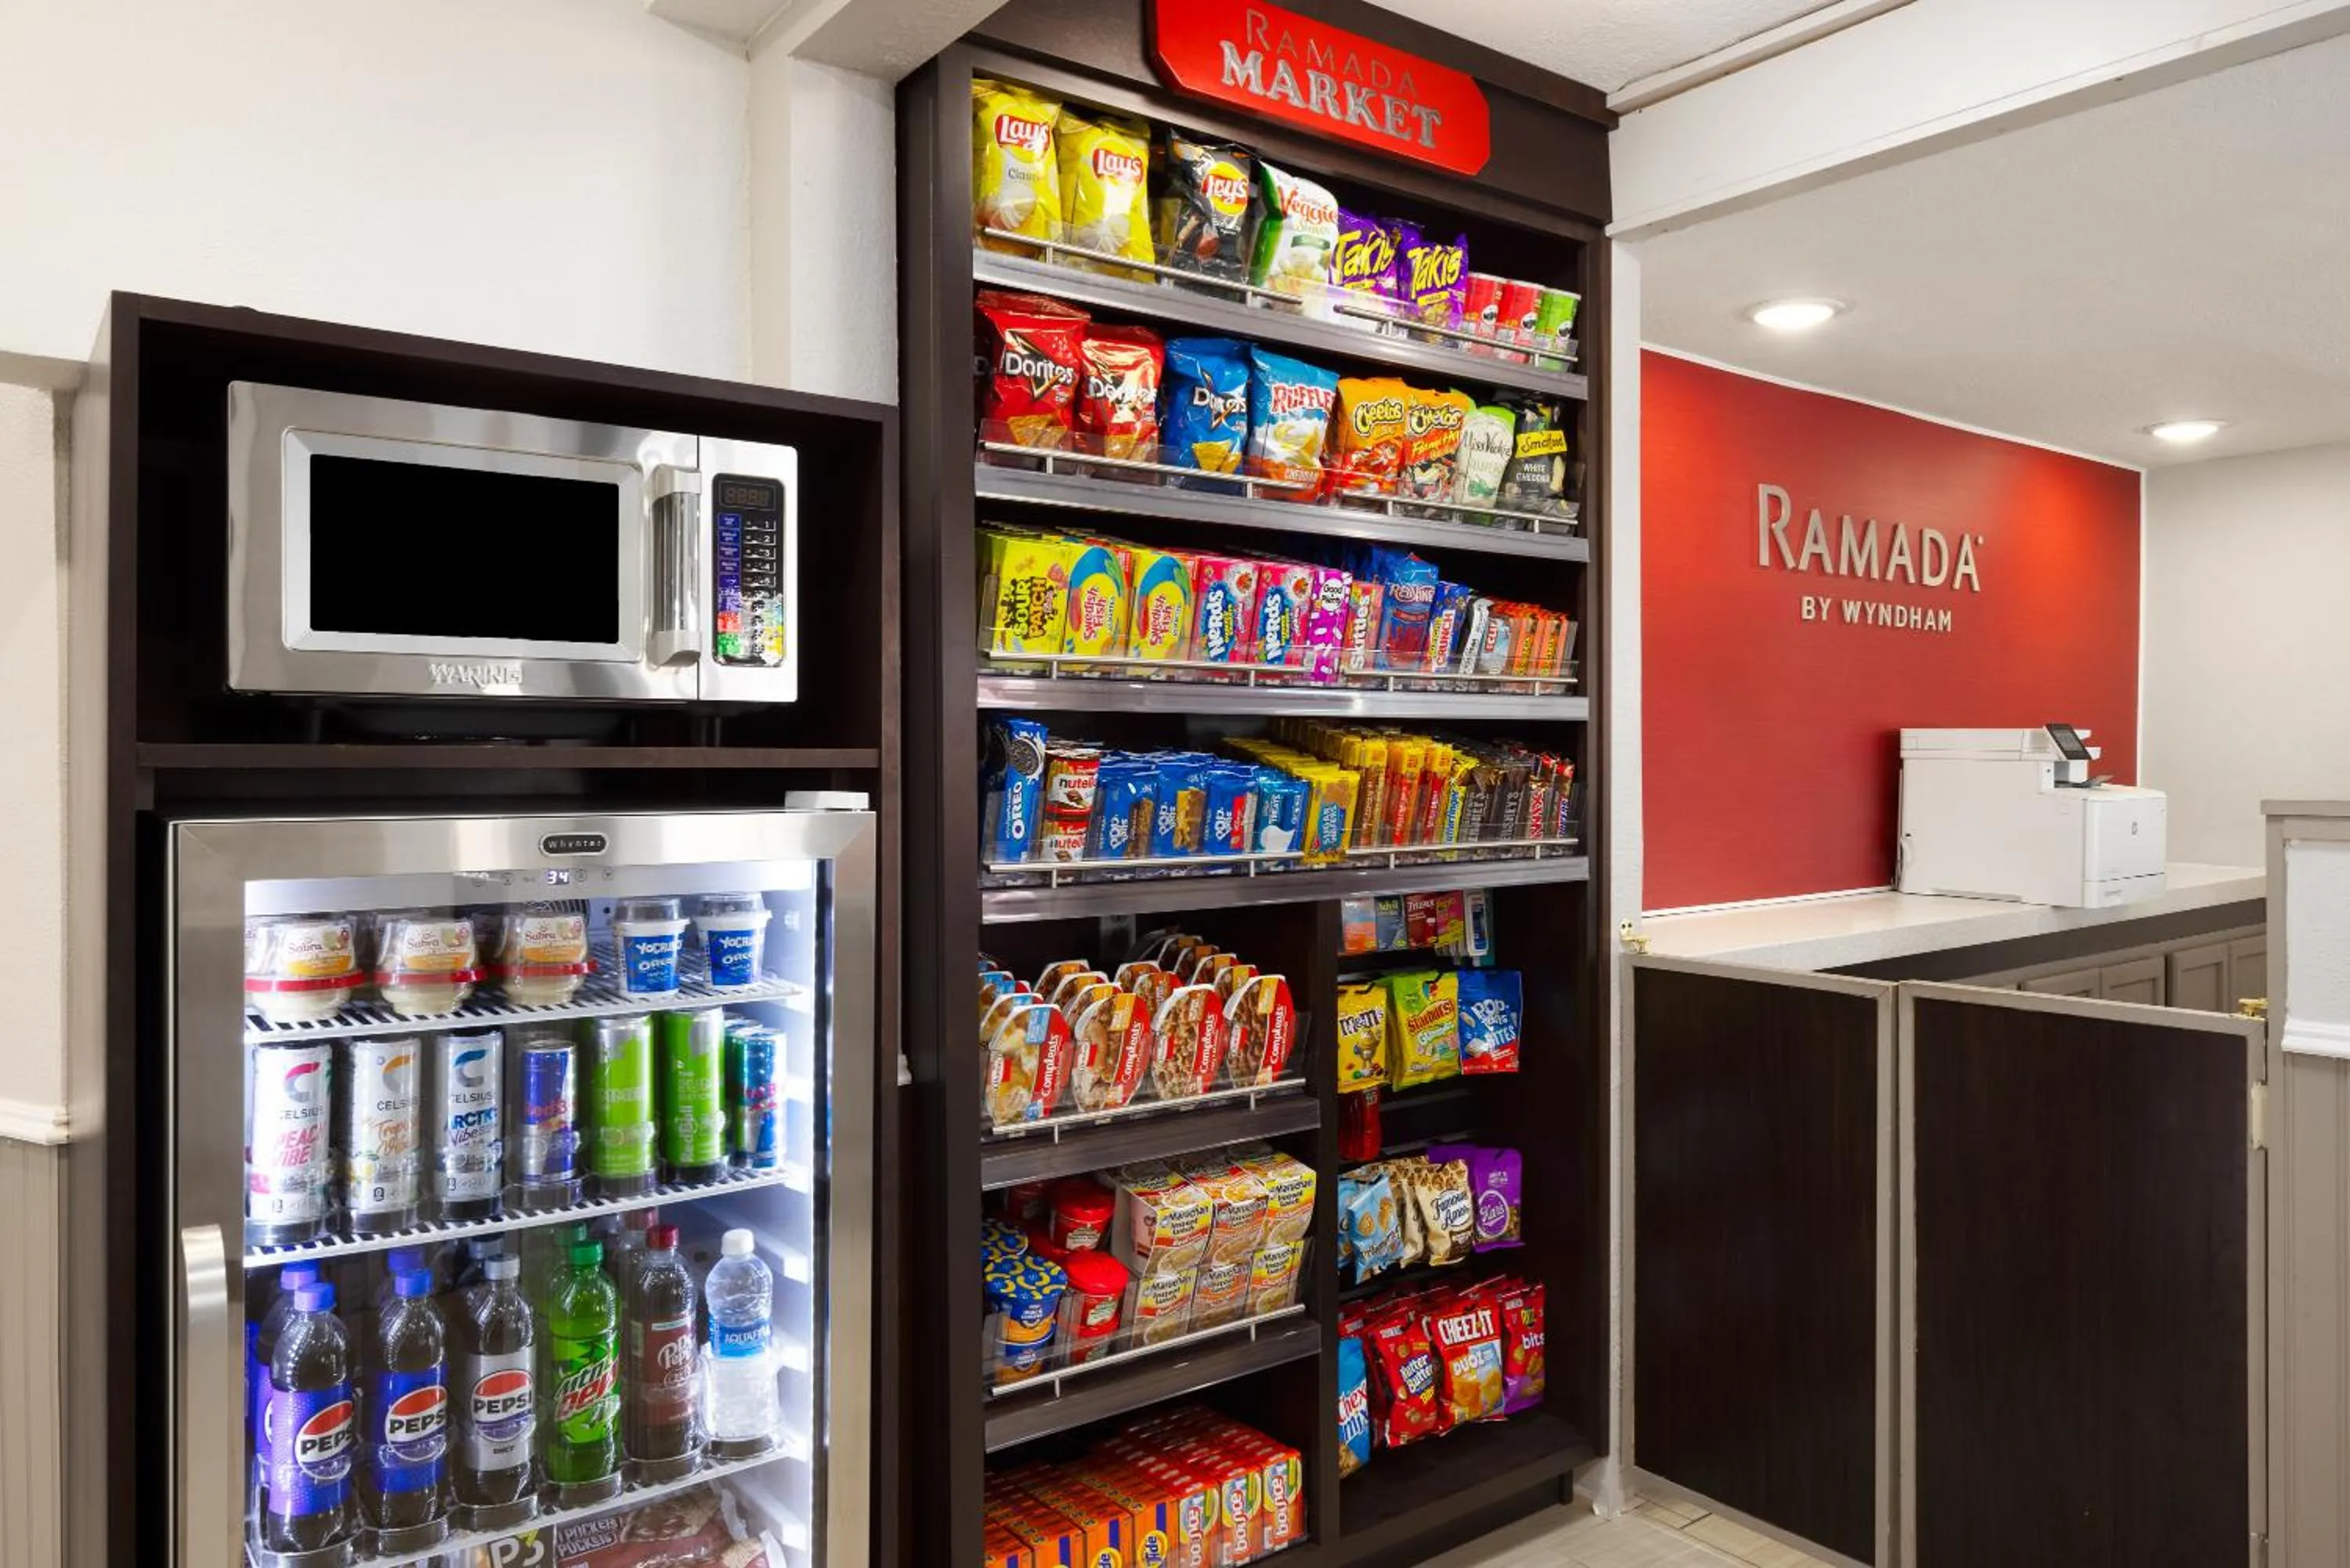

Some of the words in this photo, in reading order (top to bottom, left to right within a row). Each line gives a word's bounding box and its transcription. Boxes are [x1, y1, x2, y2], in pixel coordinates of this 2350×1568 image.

[1246, 7, 1419, 99] RAMADA
[1220, 40, 1442, 149] MARKET
[1000, 116, 1050, 151] Lay's
[1097, 150, 1142, 182] Lay's
[1207, 174, 1249, 204] Lay's
[1278, 186, 1337, 225] Veggie
[1332, 228, 1397, 284] Takis
[1408, 244, 1463, 300] Takis
[1004, 351, 1075, 385] Doritos
[1355, 399, 1404, 436] Cheetos
[1409, 403, 1463, 436] Cheetos
[1757, 482, 1982, 592] RAMADA
[1323, 583, 1343, 594] Good
[1011, 578, 1032, 638] SOUR
[1027, 576, 1048, 639] PATCH
[1083, 585, 1099, 643] Swedish
[1094, 595, 1107, 630] Fish
[1149, 592, 1166, 646] Swedish
[1161, 604, 1173, 637] Fish
[1802, 596, 1832, 621] BY
[1842, 599, 1952, 632] WYNDHAM
[1350, 594, 1370, 670] Skittles
[1436, 611, 1454, 666] CRUNCH
[430, 663, 522, 688] WARING
[1012, 781, 1025, 840] OREO
[1268, 793, 1282, 825] TREATS
[1443, 789, 1459, 844] utterfinger
[548, 870, 569, 883] 34
[288, 941, 323, 955] Sabra
[407, 937, 440, 948] Sabra
[1199, 1013, 1216, 1075] Compleats
[1271, 1004, 1285, 1065] Compleats
[1041, 1034, 1061, 1097] Compleats
[1121, 1021, 1142, 1084] Compleats
[280, 1106, 324, 1120] ELSIUS
[1276, 1177, 1312, 1195] Maruchan
[1170, 1205, 1209, 1220] Maruchan
[1227, 1201, 1266, 1216] Maruchan
[1432, 1189, 1469, 1221] Famous
[1441, 1205, 1470, 1230] Amos
[1151, 1275, 1192, 1292] Maruchan
[1522, 1332, 1545, 1350] bits
[1406, 1364, 1433, 1394] Butter
[473, 1393, 532, 1414] PEPSI
[389, 1412, 446, 1434] PEPS
[301, 1427, 353, 1455] PEPS
[1231, 1489, 1249, 1552] bounce
[1272, 1476, 1289, 1537] bounce
